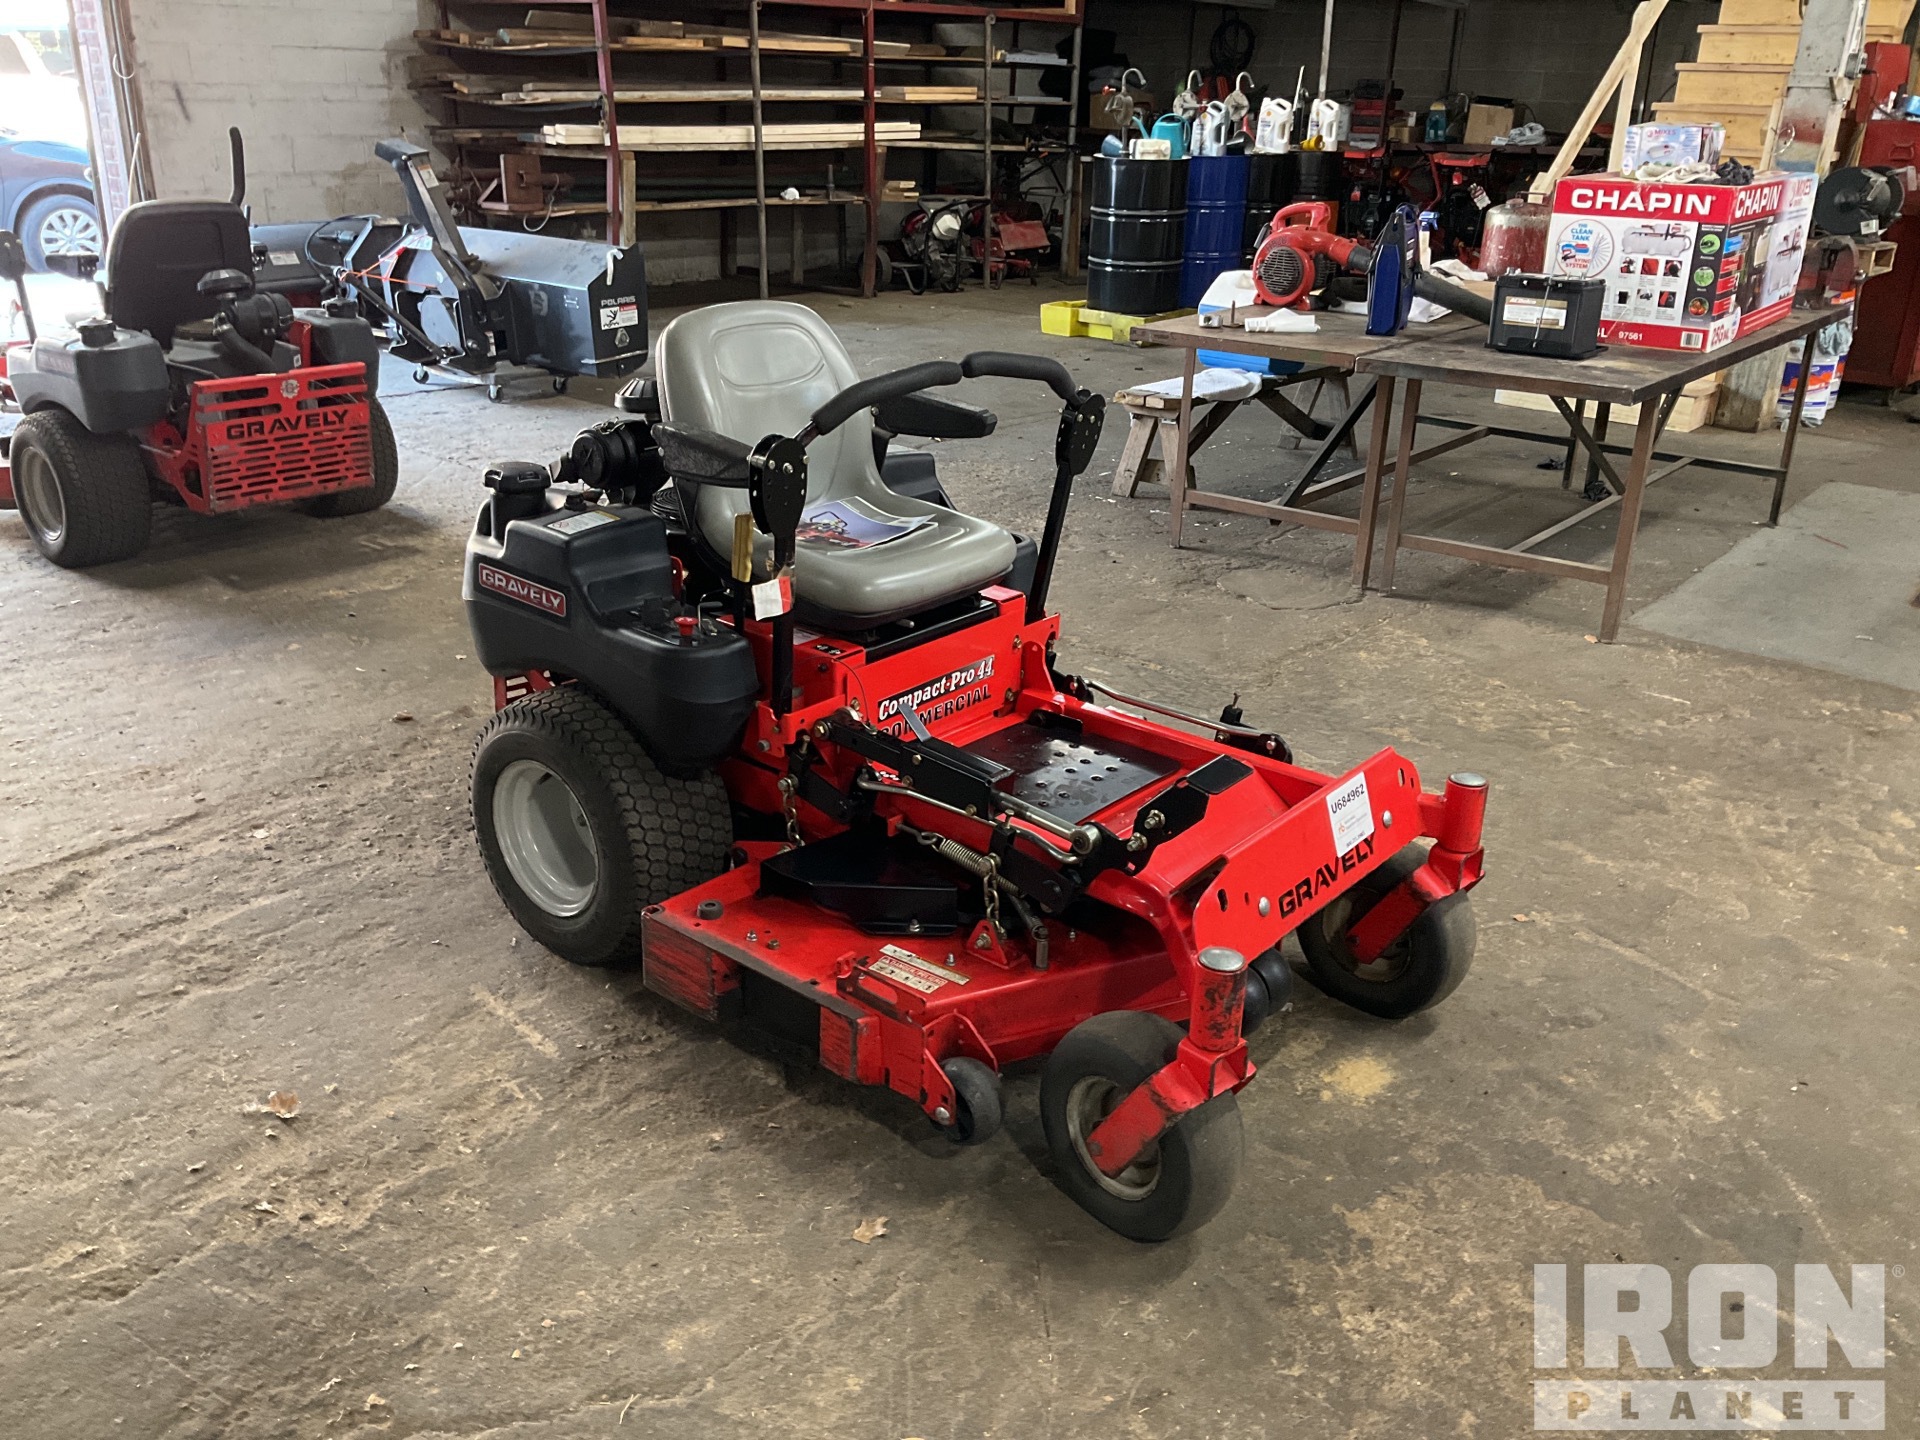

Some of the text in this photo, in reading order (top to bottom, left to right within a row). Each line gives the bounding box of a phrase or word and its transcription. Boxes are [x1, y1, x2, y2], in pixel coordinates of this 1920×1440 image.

[1571, 188, 1712, 216] CHAPIN
[1734, 185, 1782, 218] CHAPIN
[600, 295, 636, 307] POLARIS
[226, 409, 349, 440] GRAVELY
[482, 569, 562, 609] GRAVELY
[976, 656, 994, 680] 44
[1331, 783, 1366, 815] U684962
[1278, 832, 1375, 920] GRAVELY
